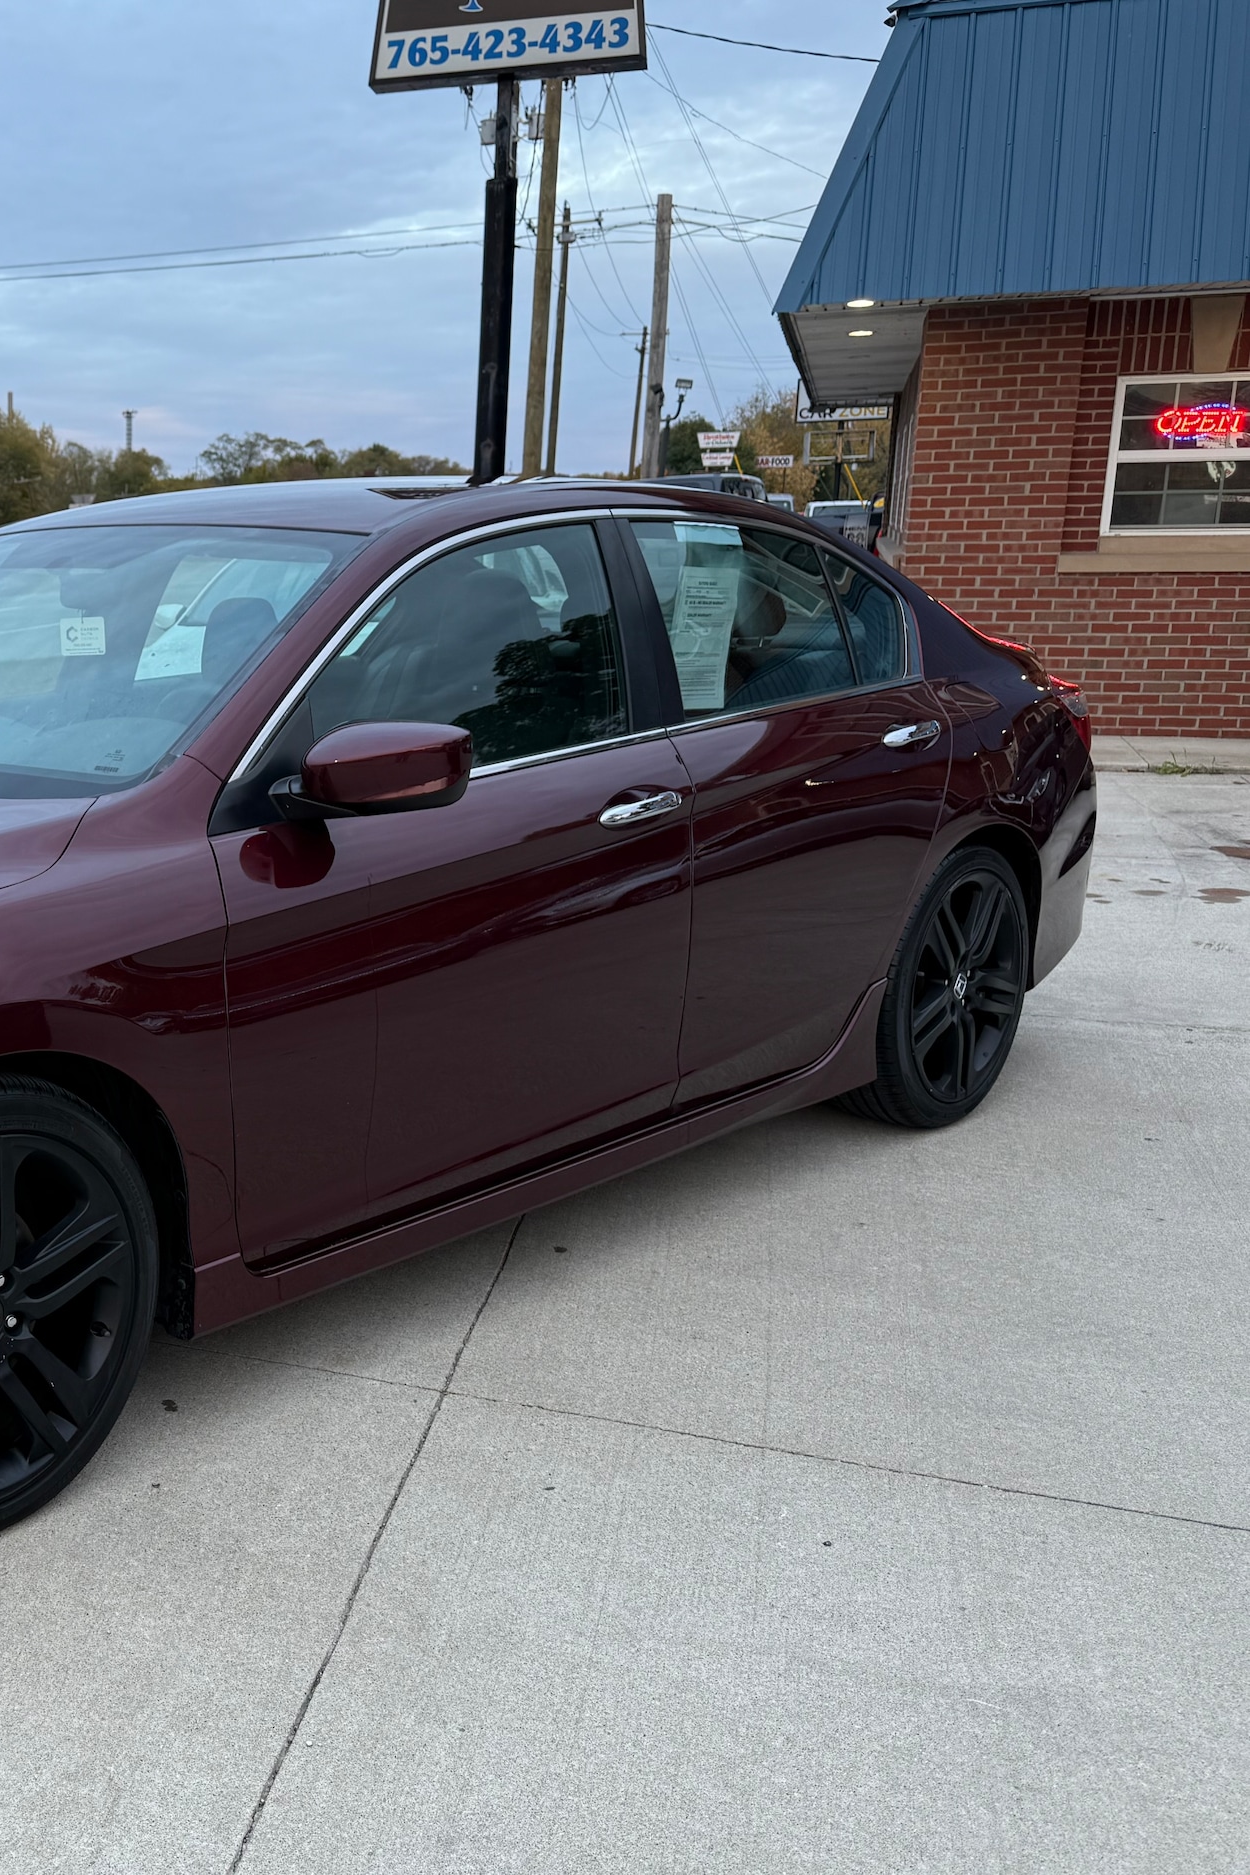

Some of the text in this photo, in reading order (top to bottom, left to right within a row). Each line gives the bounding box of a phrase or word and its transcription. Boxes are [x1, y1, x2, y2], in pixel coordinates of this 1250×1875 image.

[387, 17, 629, 69] 765-423-4343
[838, 406, 886, 417] ZONE
[1157, 410, 1244, 433] OPEN
